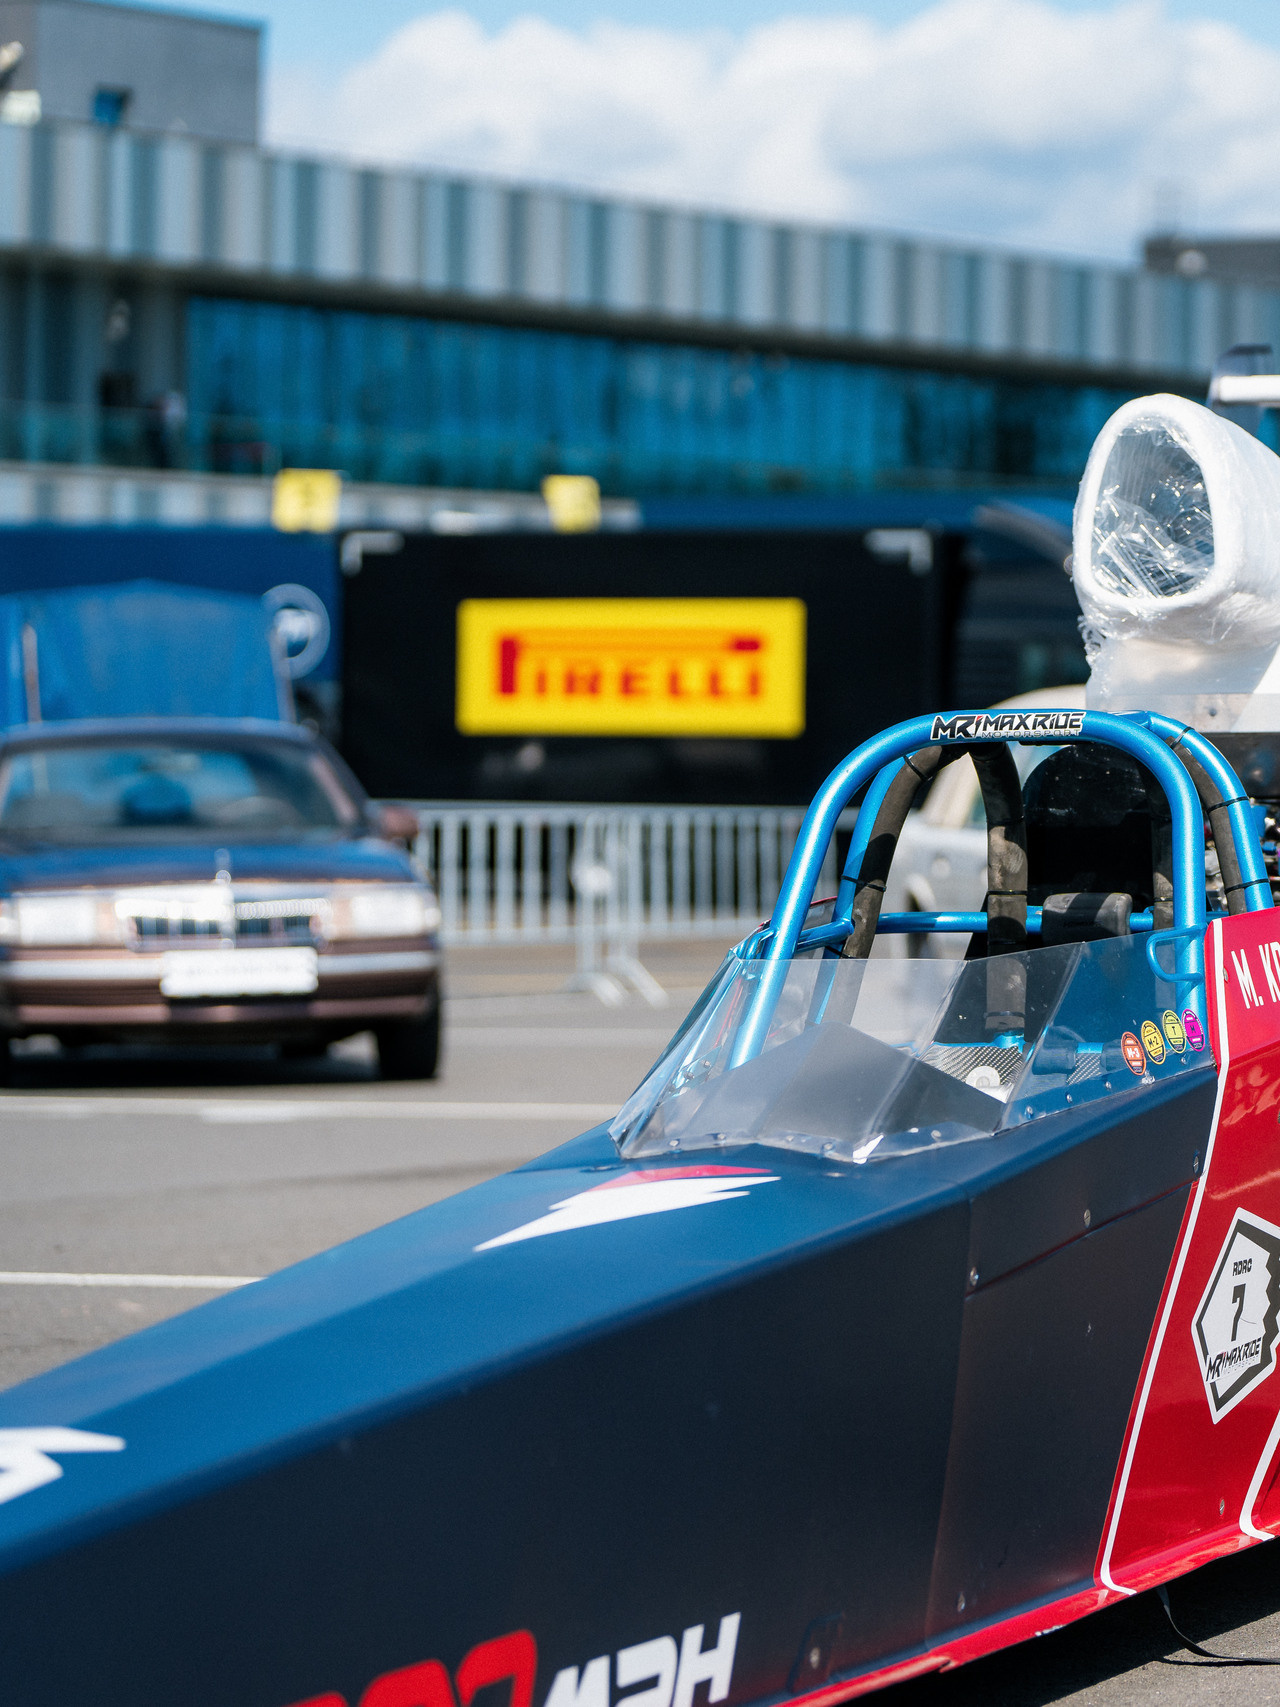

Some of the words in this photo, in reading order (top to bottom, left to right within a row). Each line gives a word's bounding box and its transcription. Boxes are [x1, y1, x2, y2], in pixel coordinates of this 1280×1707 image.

[496, 629, 764, 698] PIRELLI
[981, 728, 1081, 739] MOTORSPORT
[1231, 948, 1264, 1009] M.
[1126, 1047, 1140, 1058] M-3
[1231, 1283, 1246, 1342] 7
